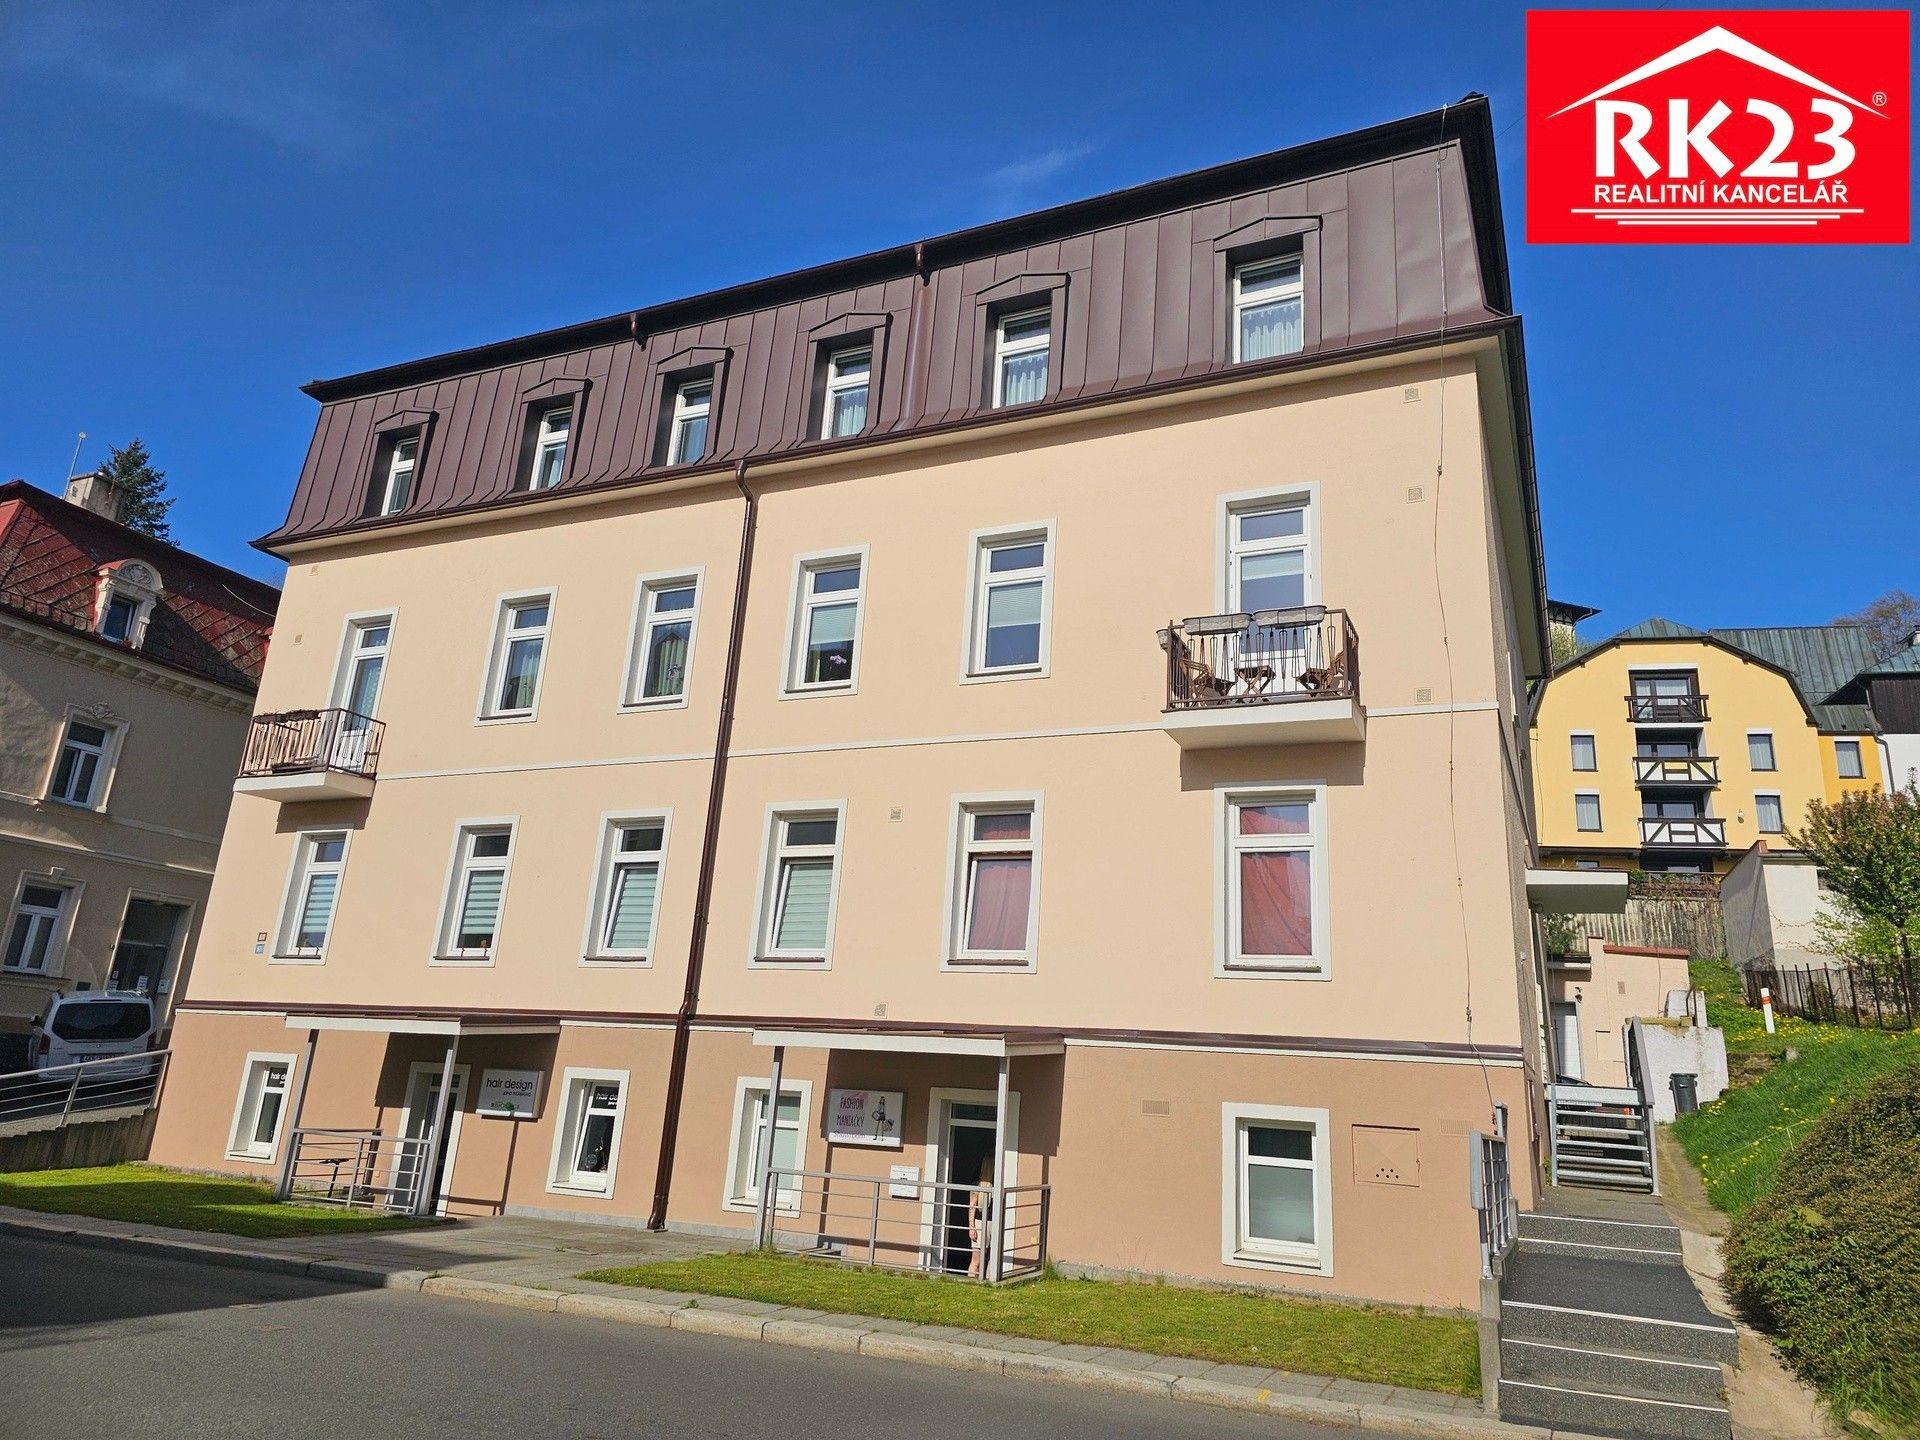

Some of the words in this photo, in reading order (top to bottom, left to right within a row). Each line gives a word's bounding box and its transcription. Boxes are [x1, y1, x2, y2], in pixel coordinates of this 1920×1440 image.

[486, 1078, 503, 1088] hair
[504, 1079, 533, 1092] design
[840, 1097, 864, 1110] FASHION
